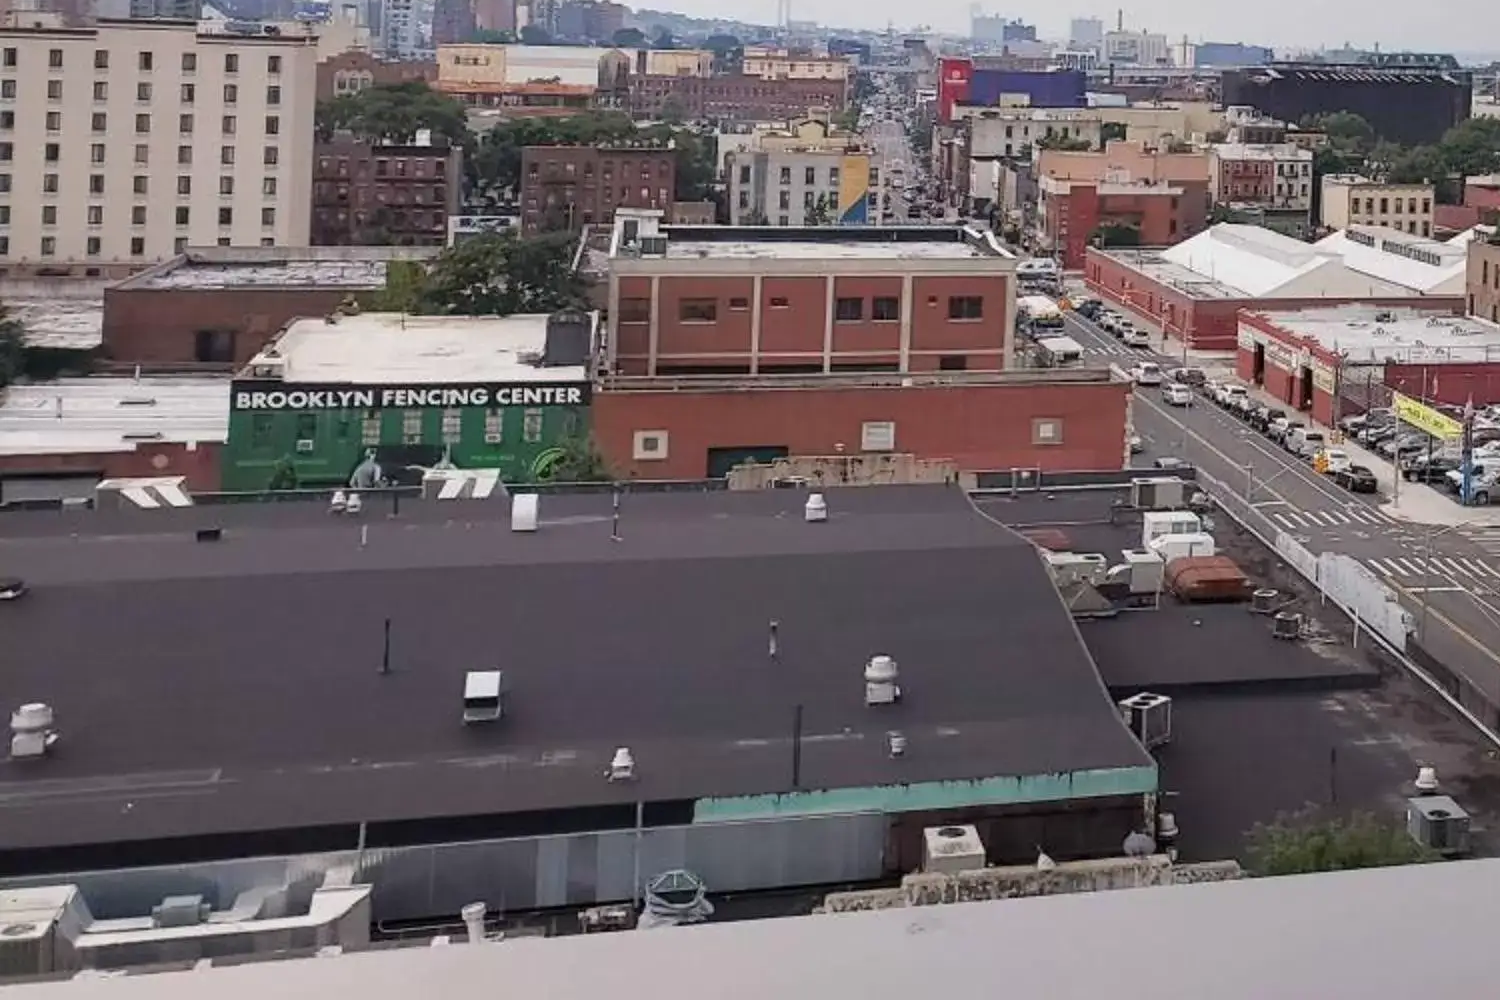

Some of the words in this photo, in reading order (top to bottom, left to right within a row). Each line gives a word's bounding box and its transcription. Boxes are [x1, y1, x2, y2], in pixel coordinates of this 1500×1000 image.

[236, 390, 373, 409] BROOKLYN
[381, 388, 489, 407] FENCING
[496, 387, 582, 404] CENTER
